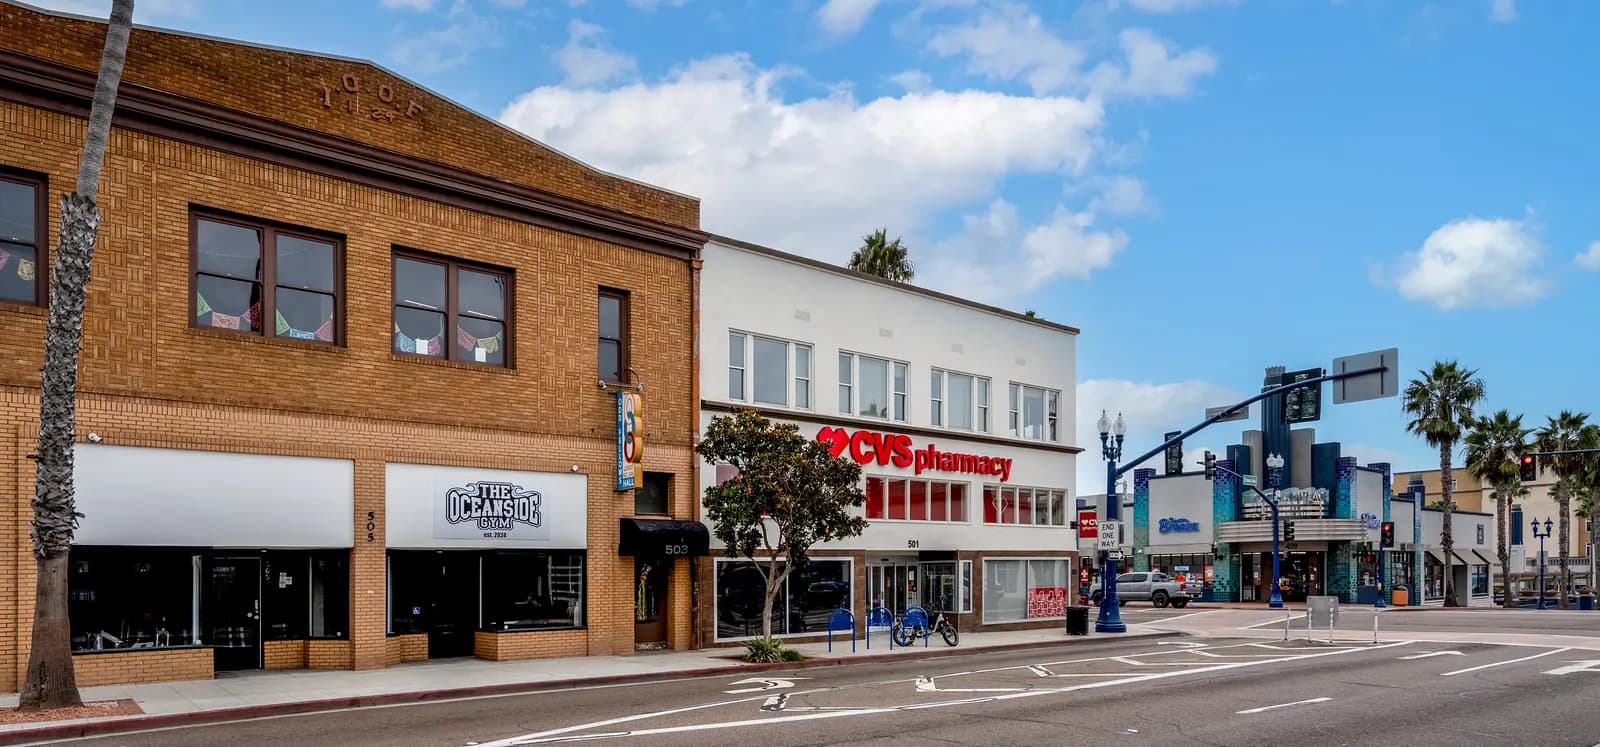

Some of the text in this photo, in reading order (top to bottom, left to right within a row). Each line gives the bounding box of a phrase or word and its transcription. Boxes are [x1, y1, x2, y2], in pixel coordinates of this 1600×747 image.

[850, 431, 1013, 482] CVS pharmacy
[479, 483, 511, 499] THE
[448, 490, 541, 526] OCEANSIDE
[367, 511, 375, 543] 505
[479, 517, 512, 529] GYM
[1102, 523, 1115, 531] END
[665, 544, 689, 555] 503
[908, 540, 919, 549] 501
[1102, 540, 1115, 548] WAY
